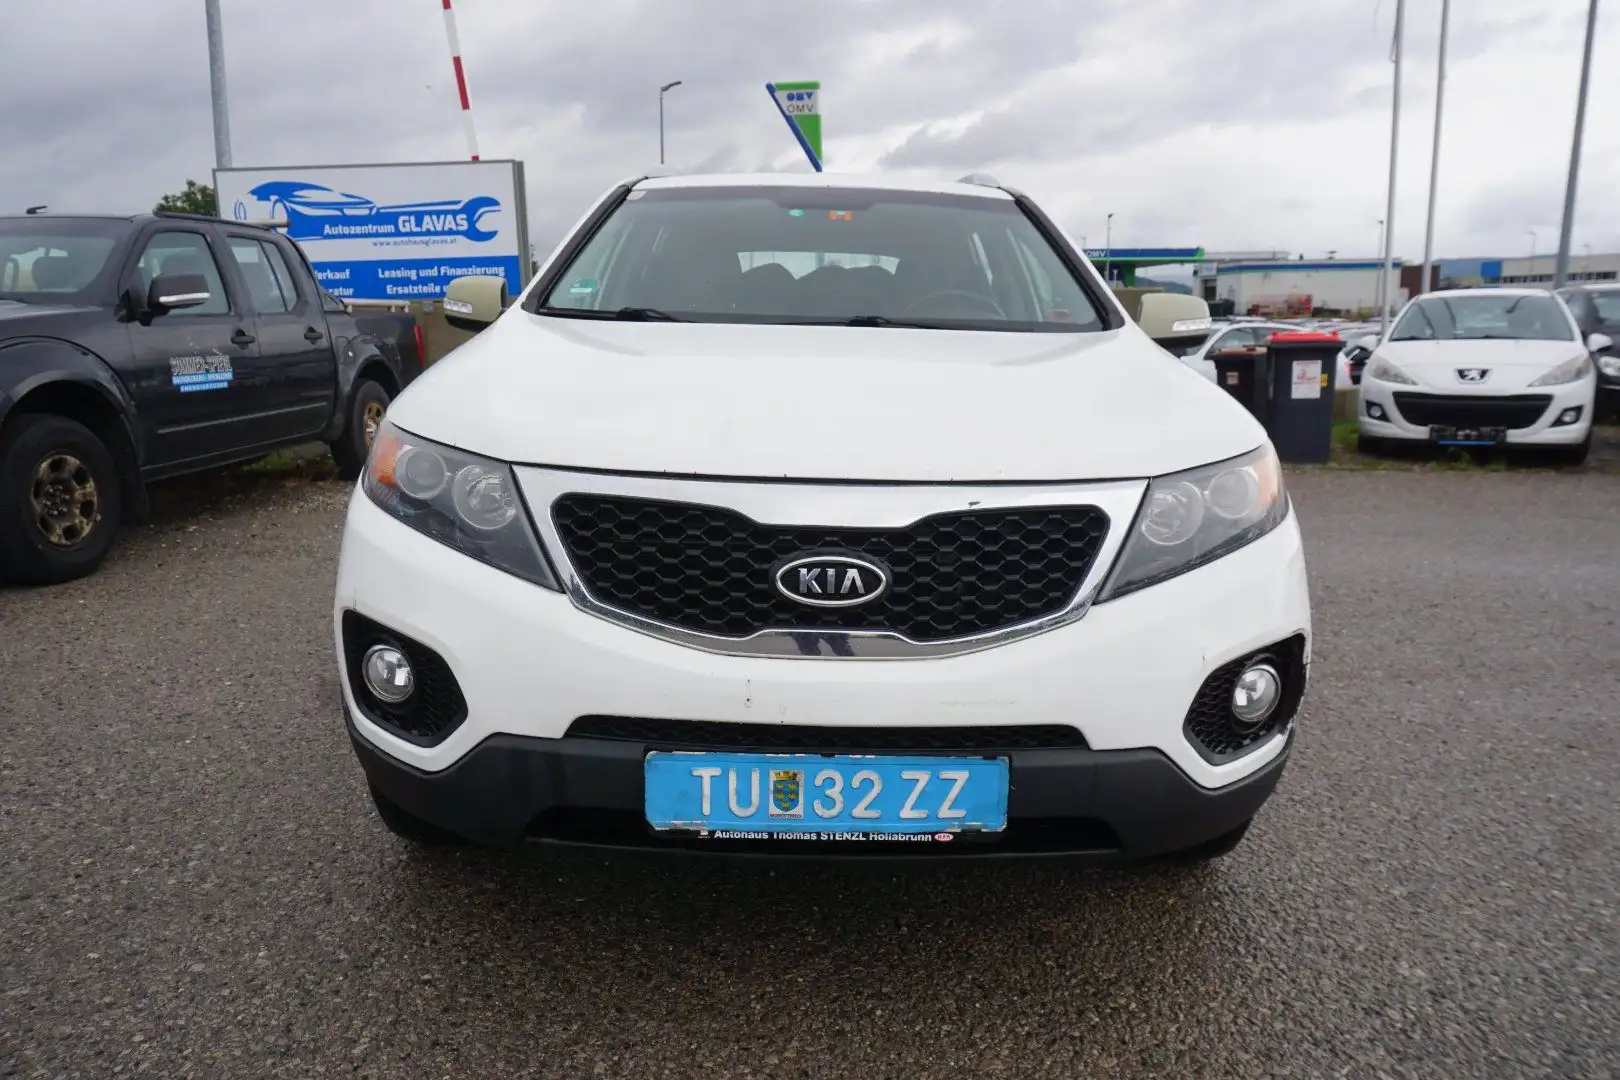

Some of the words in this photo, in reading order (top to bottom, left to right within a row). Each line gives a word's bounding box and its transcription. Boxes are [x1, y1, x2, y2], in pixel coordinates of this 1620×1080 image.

[786, 103, 814, 114] OMV
[323, 223, 396, 235] Autozentrum
[398, 213, 469, 233] GLAVAS
[1086, 250, 1106, 258] OMV
[315, 268, 351, 280] erkauf
[378, 268, 418, 280] Leasing
[419, 266, 438, 277] und
[440, 265, 505, 277] Finanzierung
[386, 283, 441, 295] Ersatzteile
[798, 567, 866, 595] KIA
[691, 767, 761, 818] TU
[813, 769, 883, 819] 32
[899, 770, 970, 819] ZZ
[714, 830, 769, 839] Autohaus
[773, 831, 818, 841] Thomas
[820, 831, 866, 841] STENZL
[869, 831, 932, 842] Hollabrunn
